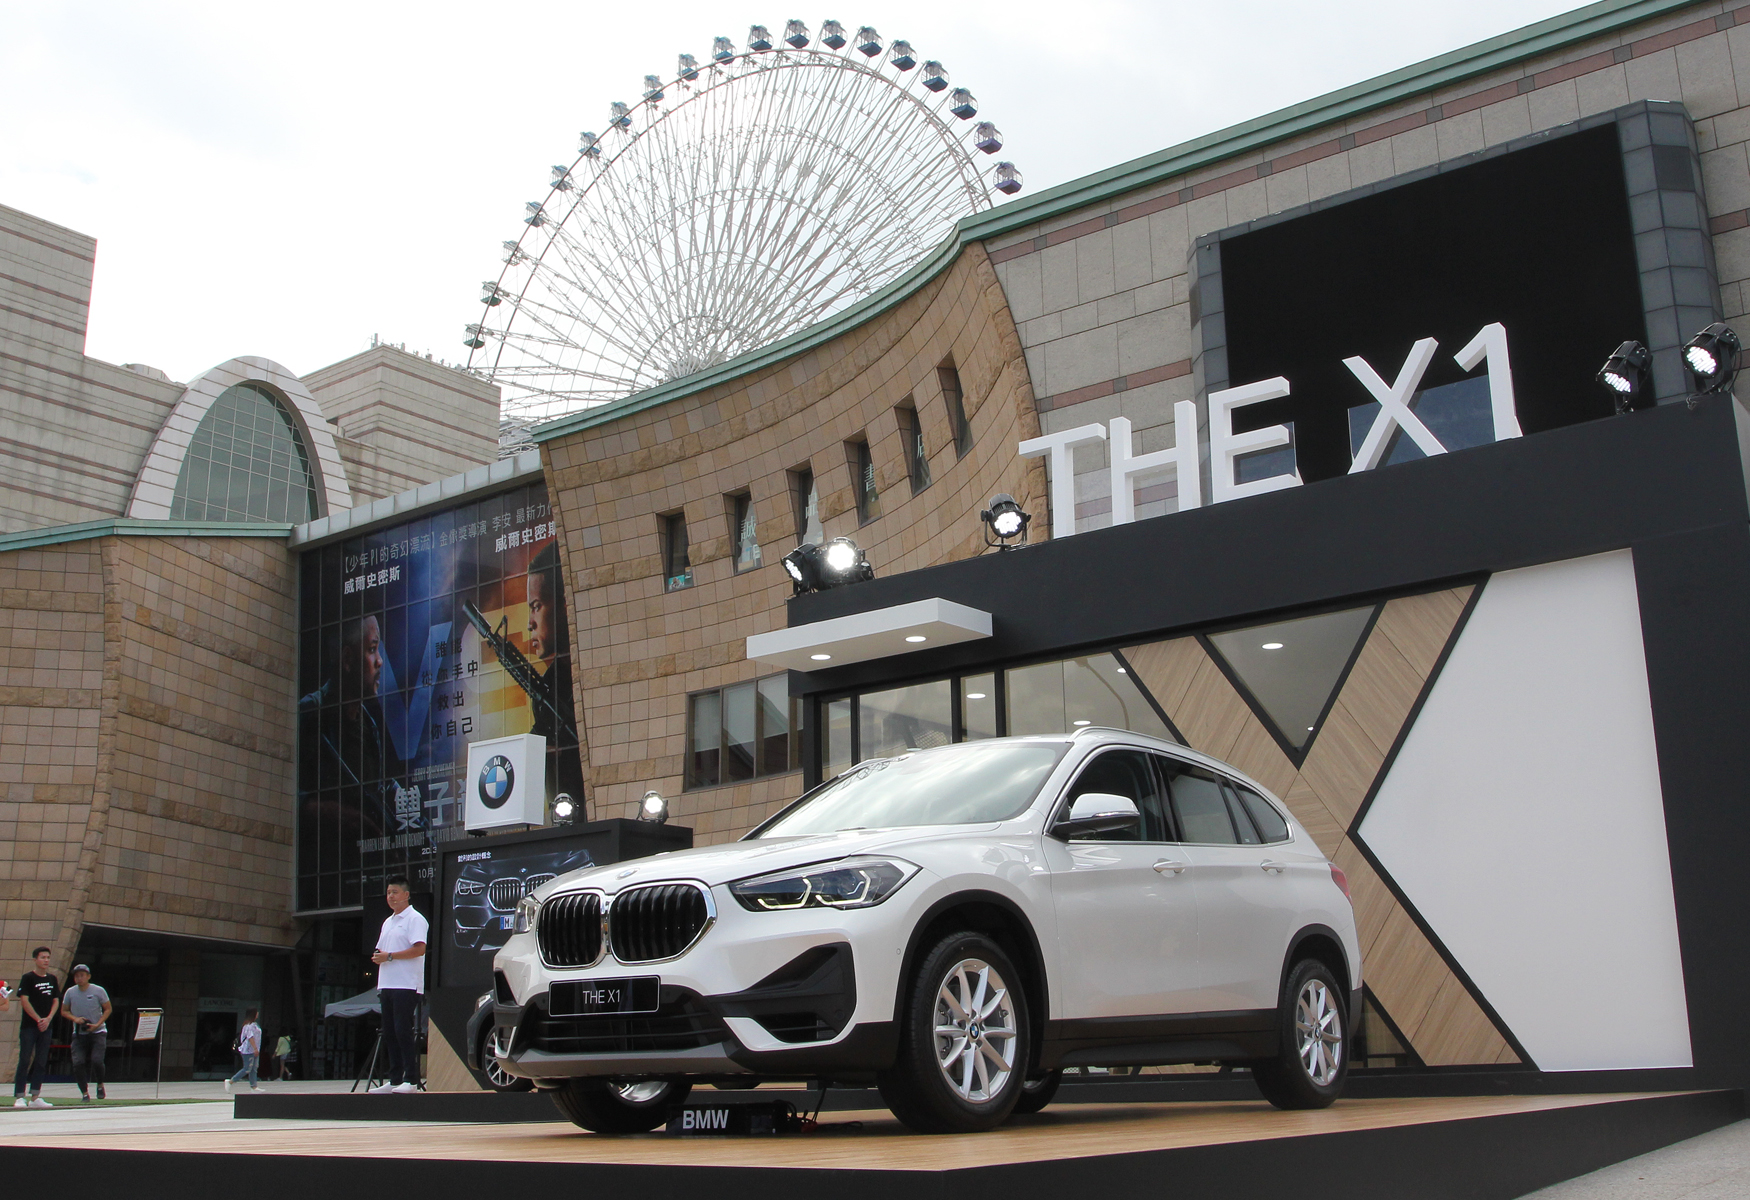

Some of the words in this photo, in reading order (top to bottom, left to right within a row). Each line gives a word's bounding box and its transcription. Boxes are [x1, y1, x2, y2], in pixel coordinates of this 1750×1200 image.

[1018, 376, 1303, 539] THE
[1342, 322, 1523, 475] X1
[344, 565, 400, 594] 威爾史密斯
[431, 717, 473, 740] 你自己
[482, 756, 512, 776] BMW
[582, 989, 605, 1005] THE
[607, 989, 620, 1003] X1
[682, 1109, 729, 1129] BMW
